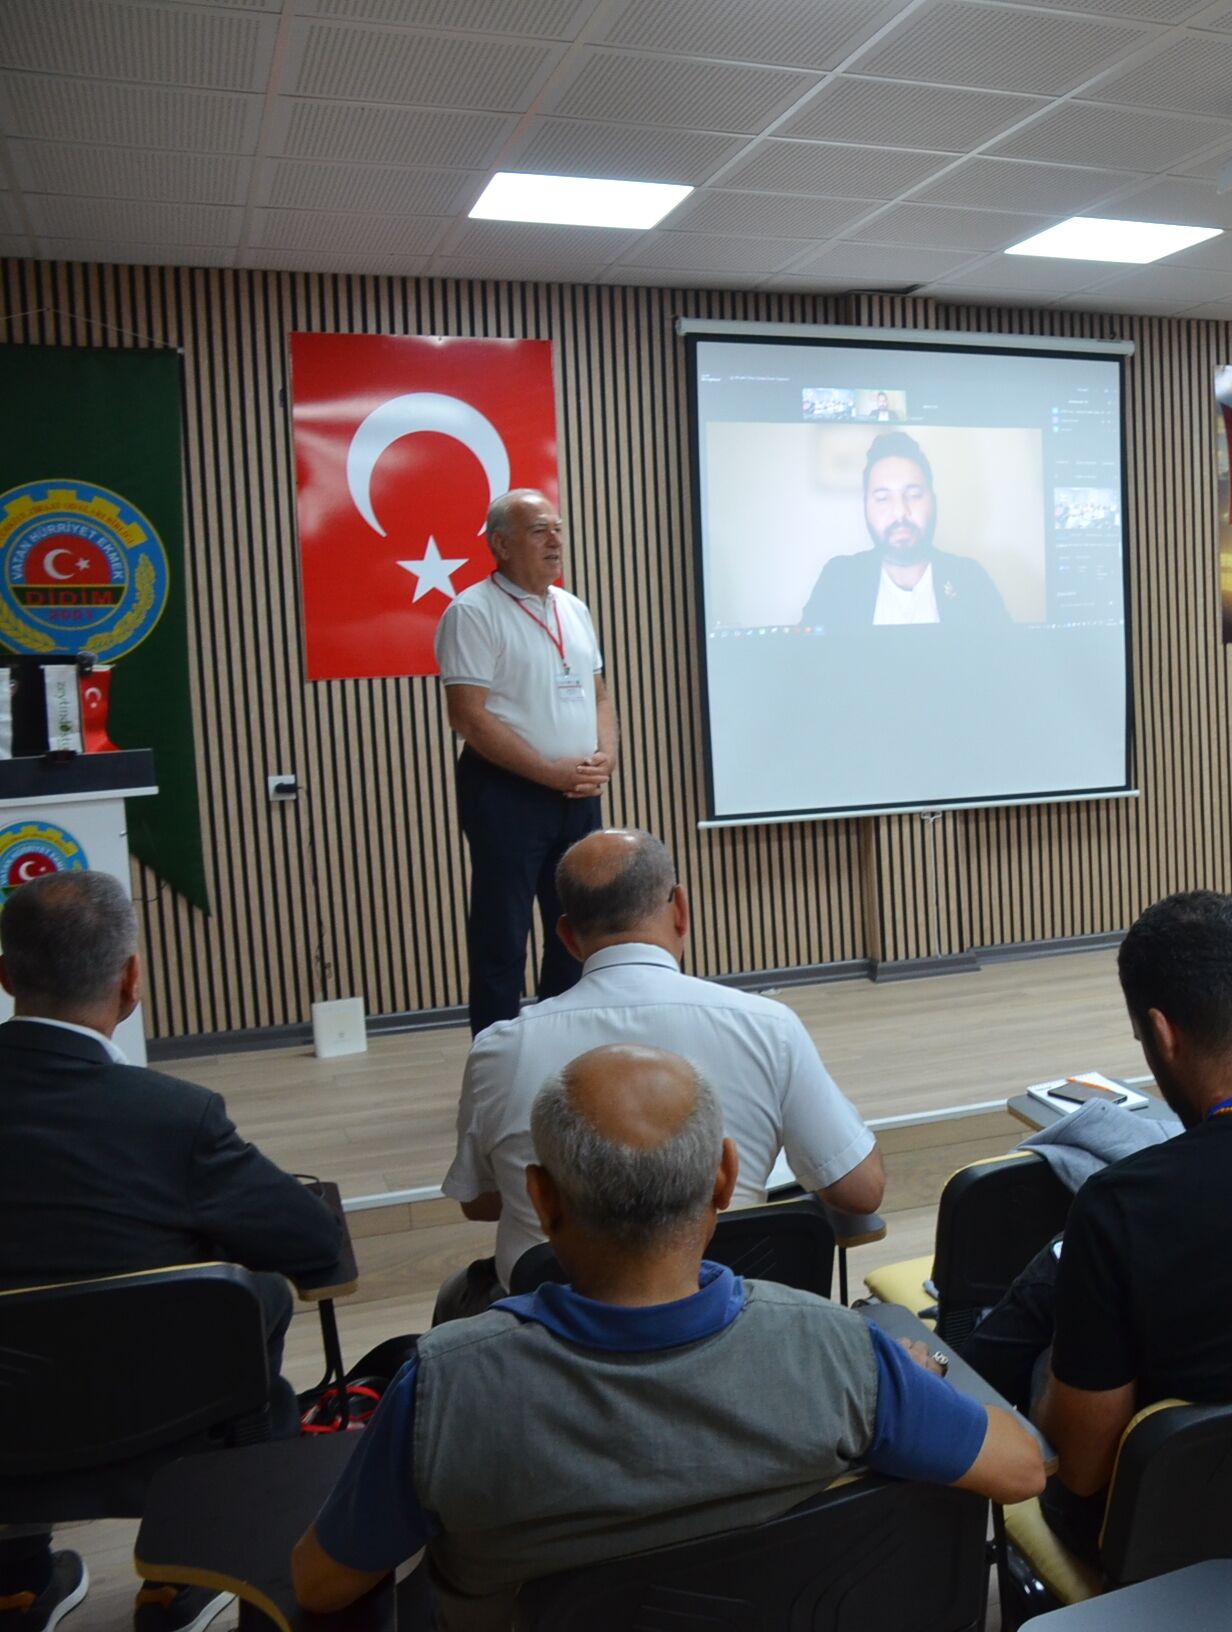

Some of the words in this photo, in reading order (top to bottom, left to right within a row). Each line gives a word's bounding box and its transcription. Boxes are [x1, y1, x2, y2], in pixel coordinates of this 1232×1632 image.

[11, 539, 33, 580] VATAN
[29, 521, 98, 541] HÜRRİYET
[96, 537, 124, 580] EKMEK
[26, 586, 114, 606] DİDİM
